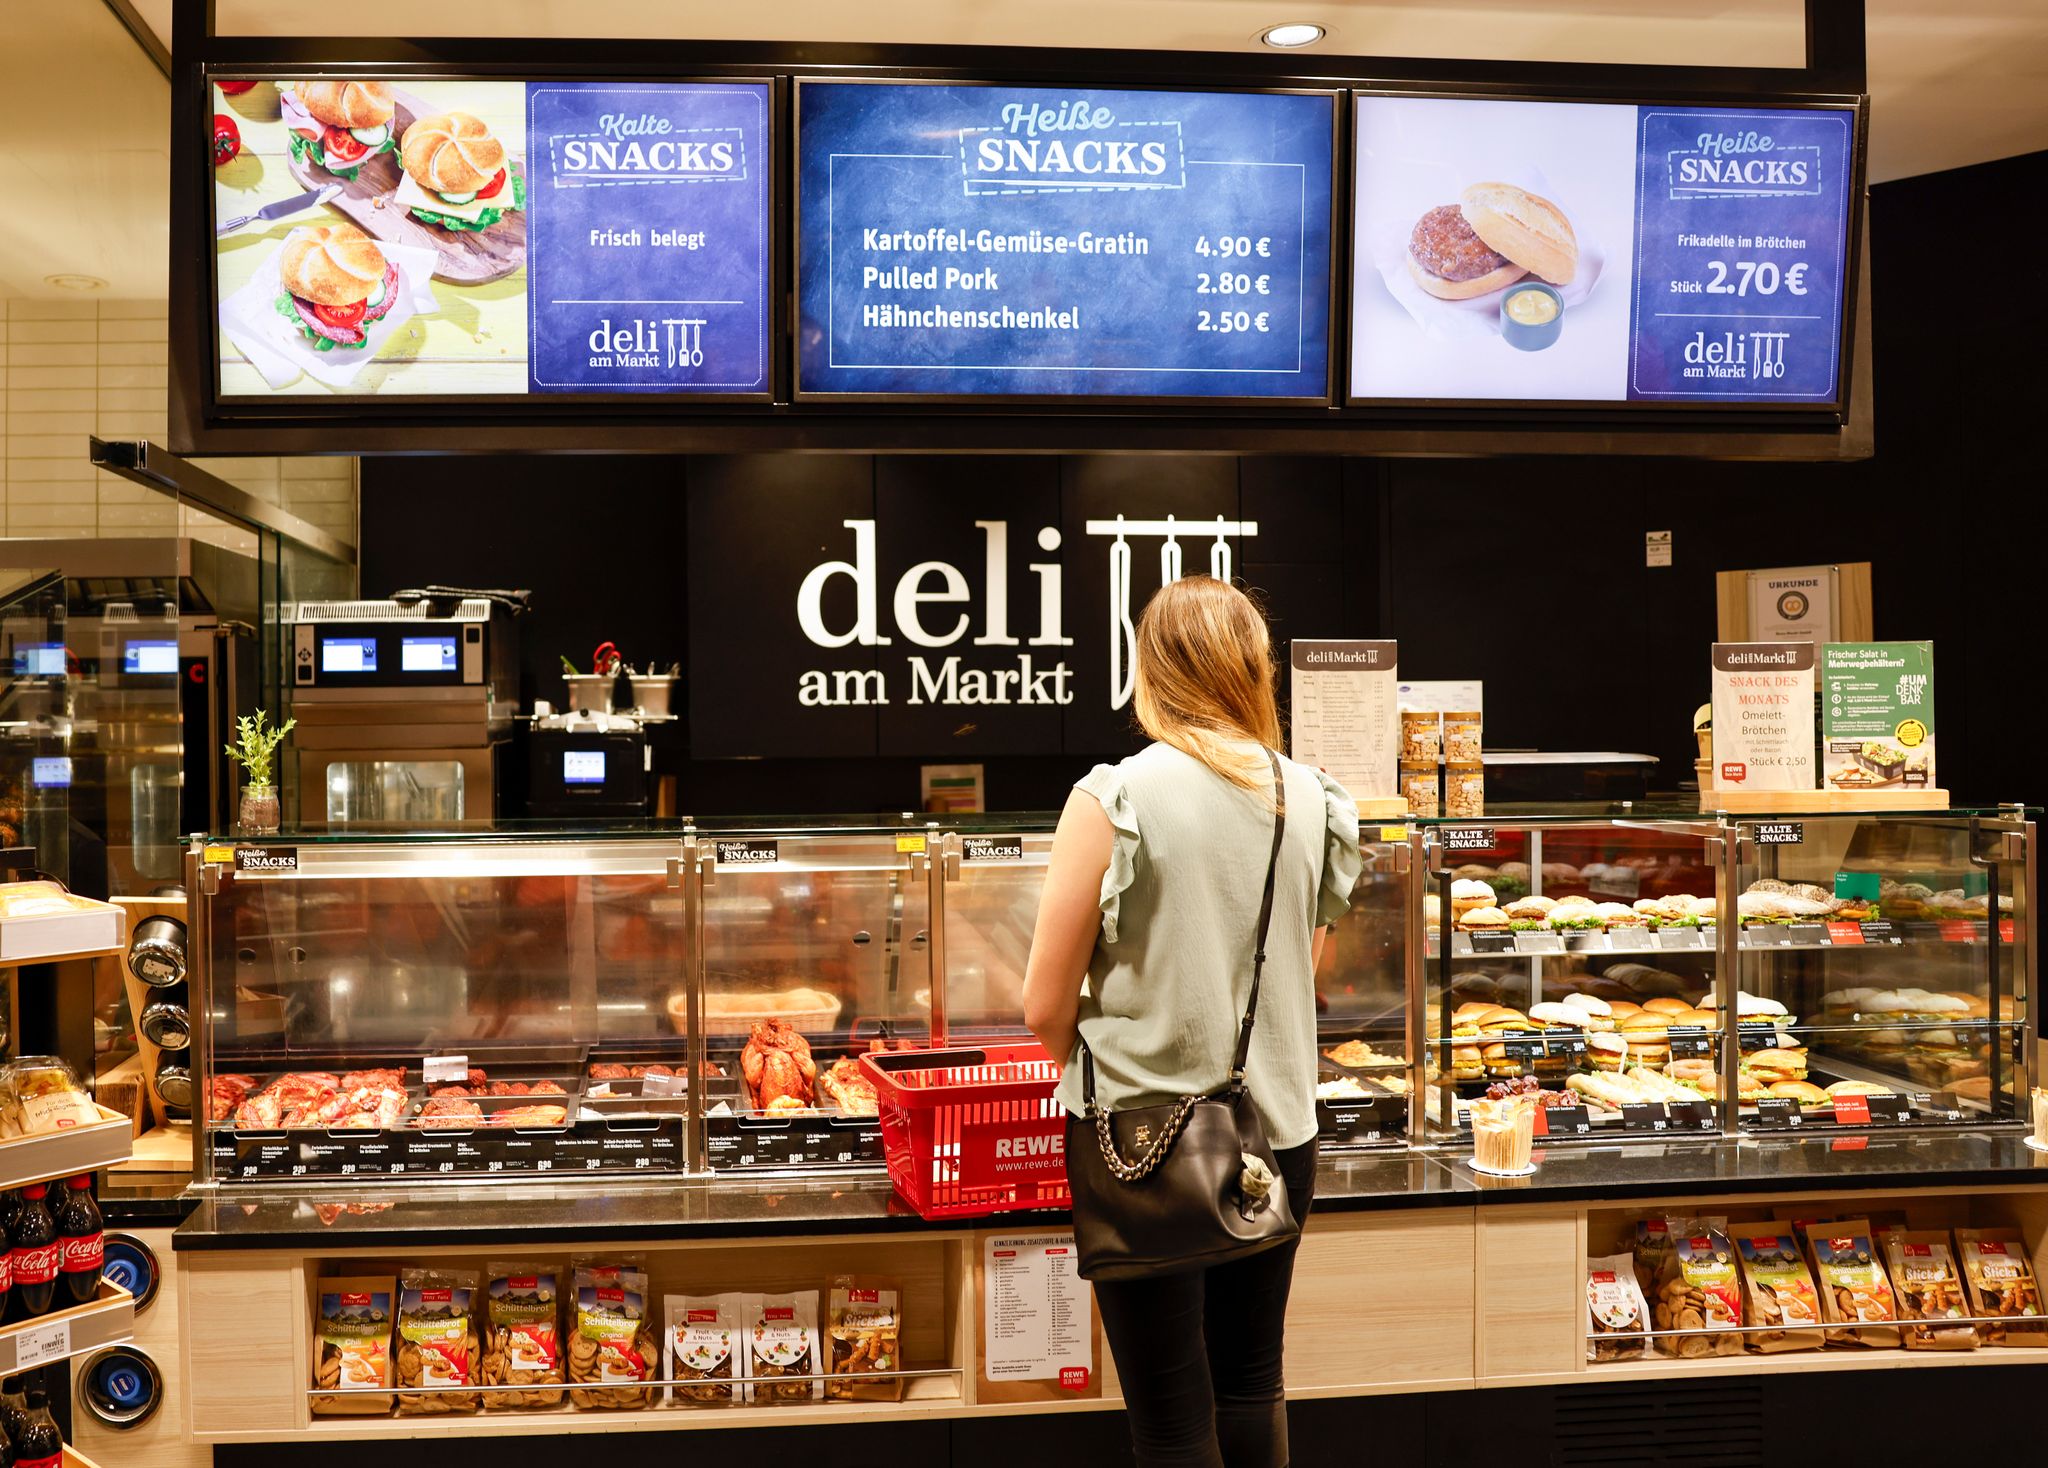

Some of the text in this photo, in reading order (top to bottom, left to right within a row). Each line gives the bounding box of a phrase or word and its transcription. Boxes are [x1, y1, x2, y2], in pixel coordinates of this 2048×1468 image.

[1001, 100, 1115, 137] Heiße
[599, 113, 672, 141] Kalte
[1697, 131, 1775, 158] Heiße
[564, 141, 733, 171] SNACKS
[977, 138, 1166, 175] SNACKS
[1680, 158, 1808, 185] SNACKS
[590, 229, 705, 250] Frisch belegt
[863, 228, 1271, 257] Kartoffel-Gemüse-Gratin 4.90 €
[1678, 234, 1806, 249] Frikadelle im Brötchen
[863, 266, 1270, 295] Pulled Pork 2.80 €
[1670, 261, 1809, 297] Stück 2.70 €
[863, 304, 1270, 332] Hähnchenschenkel 2.50 €
[589, 319, 659, 352] deli
[1684, 332, 1746, 364] deli
[589, 353, 660, 367] am Markt
[1683, 365, 1746, 378] am Markt
[796, 520, 1074, 648] deli
[1769, 579, 1818, 589] URKUNDE
[1306, 651, 1367, 663] deli Markt
[1727, 653, 1785, 664] deli Markt
[1828, 650, 1888, 659] Frischer Salat in
[1828, 659, 1905, 669] Mehrwegbehältern?
[798, 654, 1074, 706] am Markt
[1730, 677, 1798, 687] SNACK DES
[1900, 674, 1927, 685] #UM
[1896, 685, 1923, 695] DENK
[1738, 695, 1790, 705] MONATS
[1900, 695, 1921, 705] BAR
[1742, 710, 1786, 720] Omelett-
[1742, 726, 1787, 735] Brötchen
[1749, 757, 1807, 766] Stück € 2,50
[1760, 825, 1792, 834] KALTE
[1449, 831, 1483, 839] KALTE
[1760, 834, 1798, 842] SNACKS
[719, 843, 746, 852] Heiße
[965, 839, 991, 848] Heiße
[1449, 839, 1489, 848] SNACKS
[238, 849, 266, 858] Heiße
[724, 850, 776, 860] SNACKS
[969, 847, 1020, 856] SNACKS
[243, 857, 295, 866] SNACKS
[996, 1134, 1064, 1158] REWE
[996, 1157, 1064, 1172] www.rewe.de
[1906, 1268, 1936, 1280] Stick
[495, 1304, 549, 1312] Schüttelbrot
[407, 1318, 460, 1328] Schüttelbrot
[585, 1317, 637, 1327] Schüttelbrot
[327, 1323, 381, 1333] Schüttelbrot
[422, 1333, 445, 1341] Original
[41, 1337, 65, 1351] EINWEG
